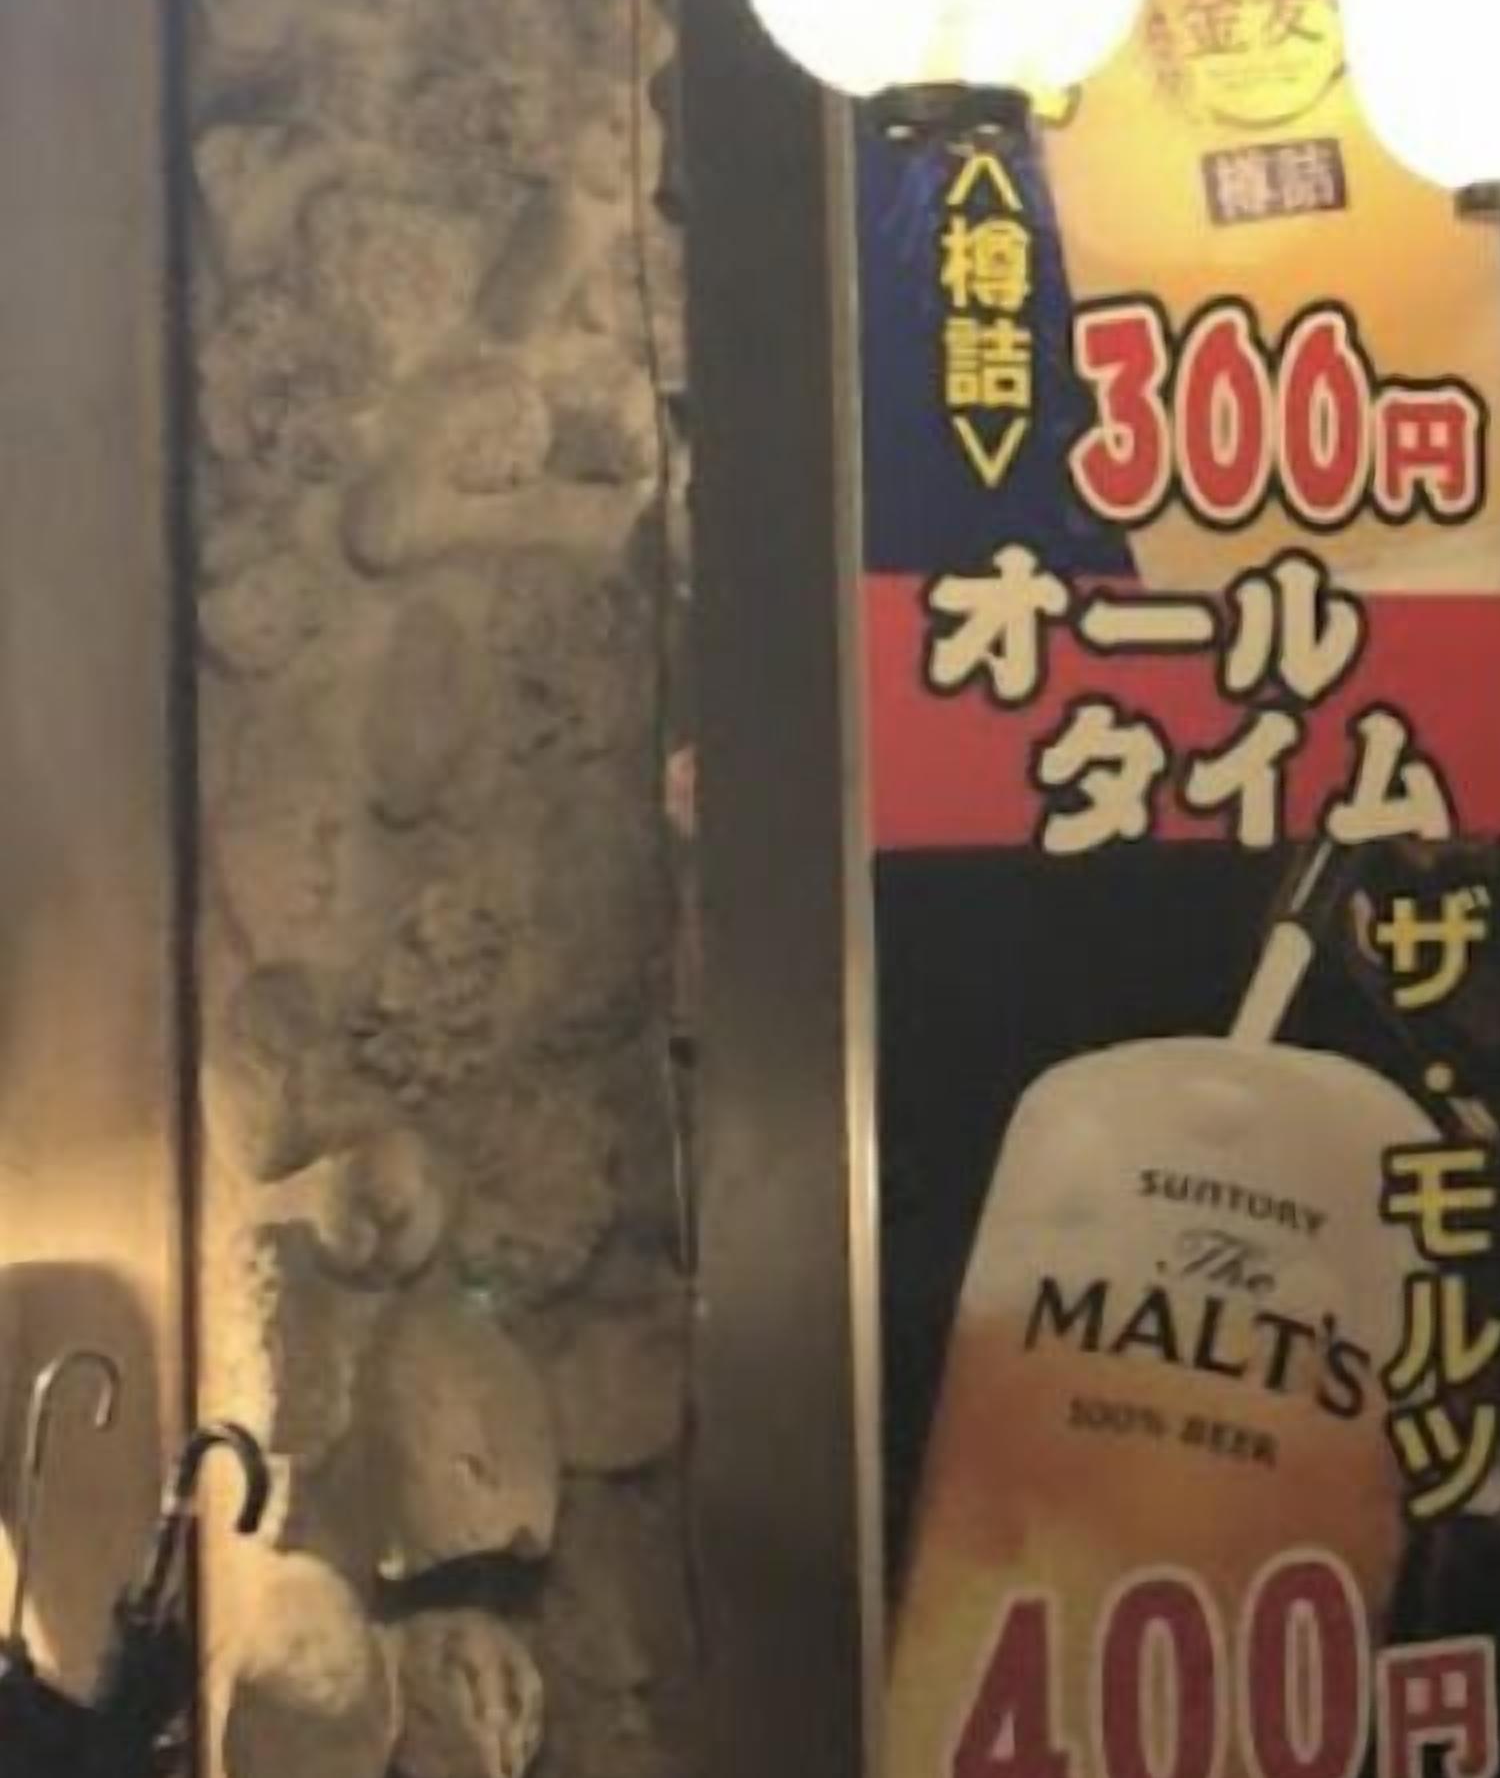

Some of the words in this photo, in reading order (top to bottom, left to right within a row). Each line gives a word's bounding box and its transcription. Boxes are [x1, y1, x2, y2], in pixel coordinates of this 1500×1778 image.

[1070, 295, 1488, 531] 300円
[925, 541, 1362, 705] オール
[1030, 703, 1455, 855] タイム
[1138, 1168, 1328, 1237] SUNTORY
[1155, 1226, 1278, 1297] The
[1023, 1275, 1372, 1421] MALT'S
[1180, 1415, 1279, 1469] BEER
